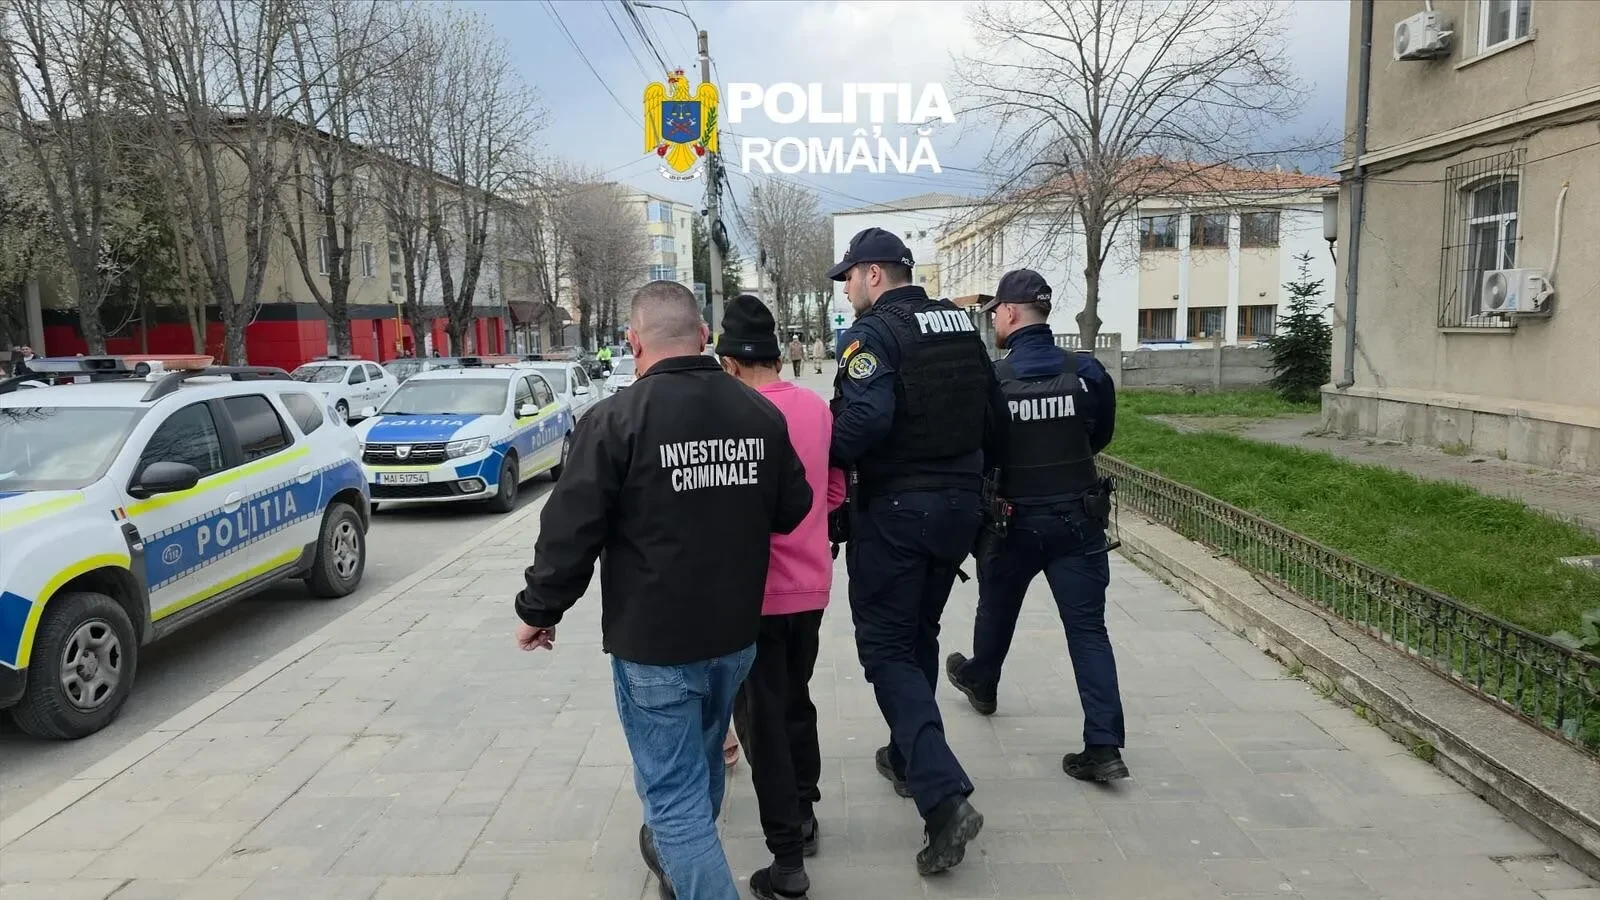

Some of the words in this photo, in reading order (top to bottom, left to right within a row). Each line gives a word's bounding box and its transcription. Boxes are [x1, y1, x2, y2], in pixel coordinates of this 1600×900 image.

[914, 310, 975, 334] POLITIA
[1008, 395, 1076, 422] POLITIA
[375, 419, 464, 427] POLITIA
[659, 438, 765, 468] INVESTIGATII
[383, 474, 397, 483] MAI
[399, 474, 424, 483] 51754
[671, 462, 758, 492] CRIMINALE
[197, 490, 297, 556] POLITIA
